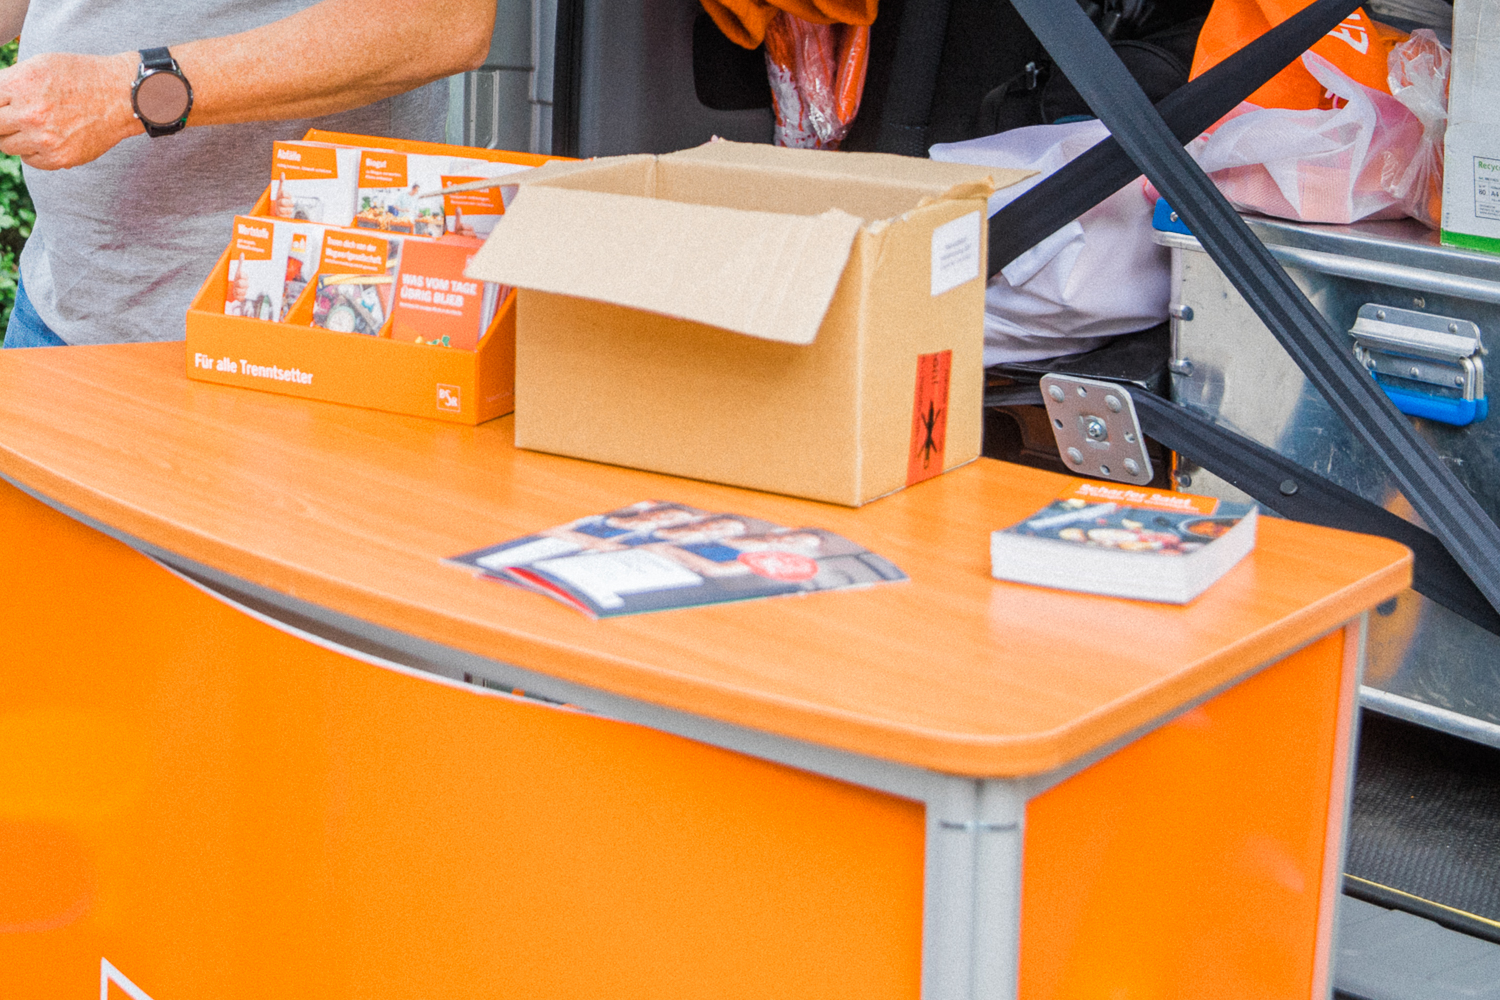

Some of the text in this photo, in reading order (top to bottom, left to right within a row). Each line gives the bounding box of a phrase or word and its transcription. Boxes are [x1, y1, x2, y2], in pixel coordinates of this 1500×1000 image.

[402, 273, 478, 296] WAS VOM TAGE
[194, 352, 314, 385] Für alle Trenntsetter
